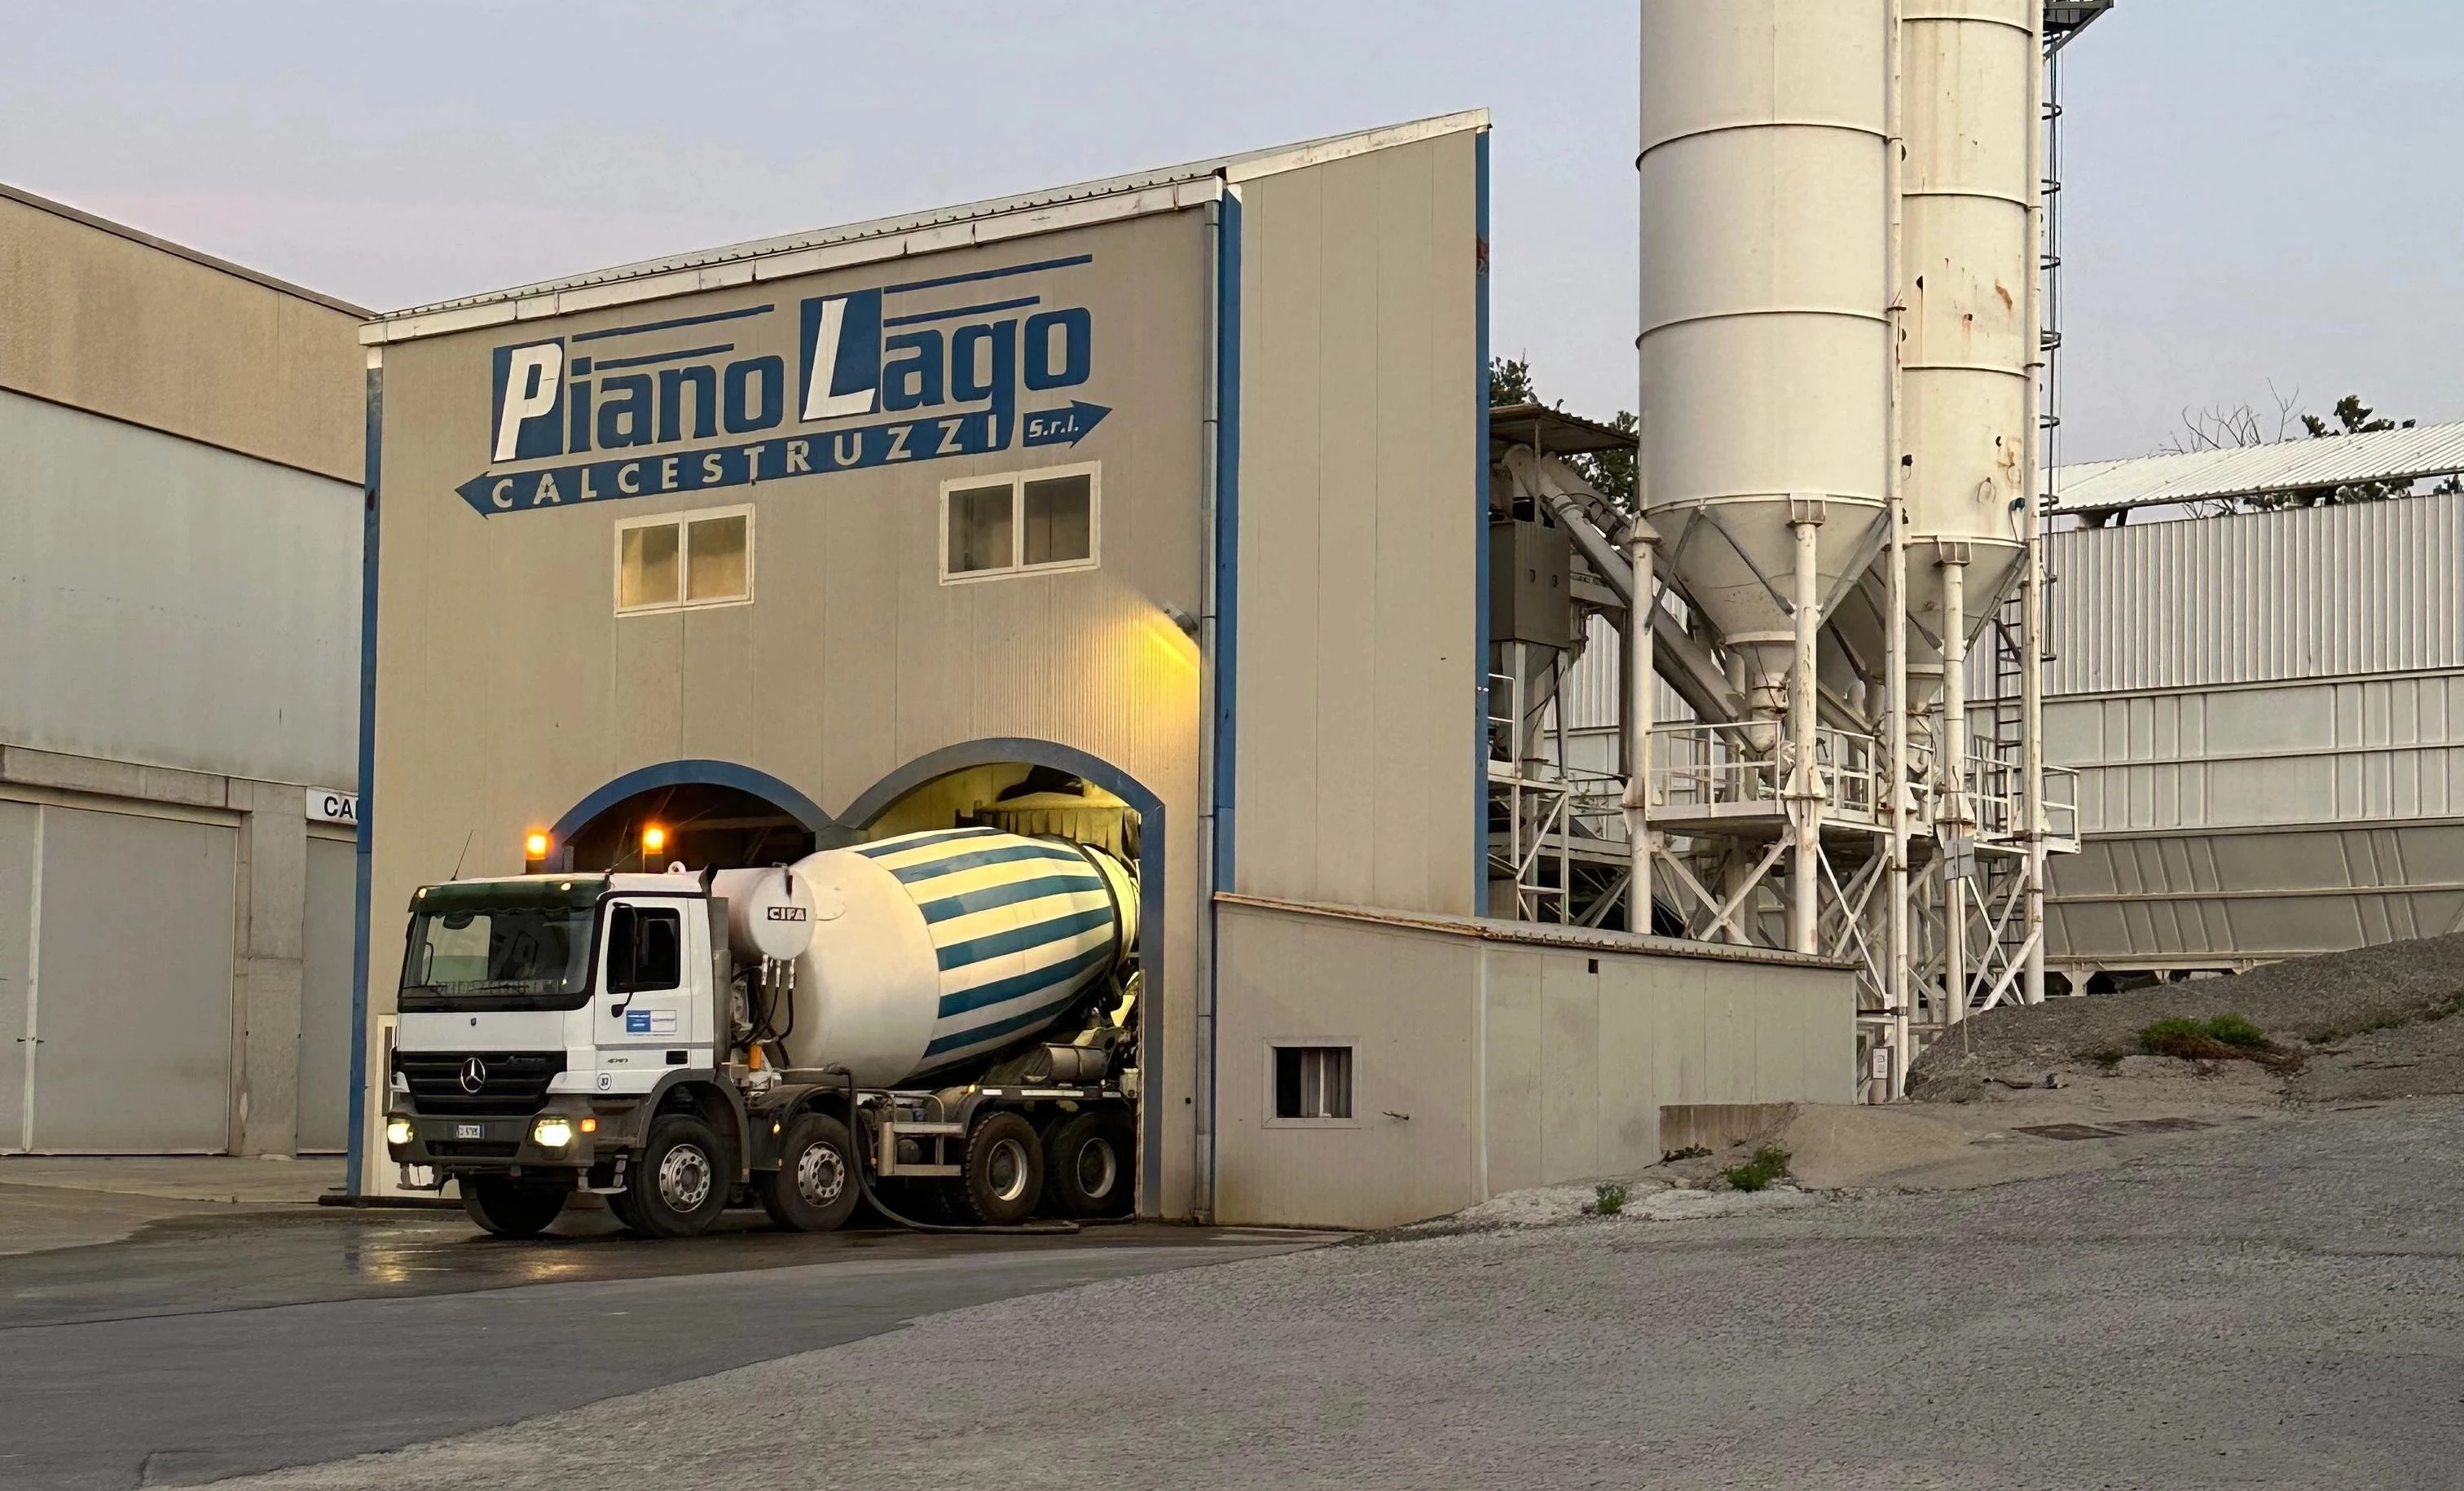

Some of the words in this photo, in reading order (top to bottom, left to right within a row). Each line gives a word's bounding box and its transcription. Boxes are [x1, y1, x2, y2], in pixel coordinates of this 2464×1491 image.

[493, 341, 784, 463] Piano
[803, 297, 1091, 451] Lago
[491, 414, 998, 509] CALCESTRUZZI
[1028, 414, 1080, 439] S.r.l.
[323, 796, 359, 820] CA
[768, 908, 805, 921] CIFA
